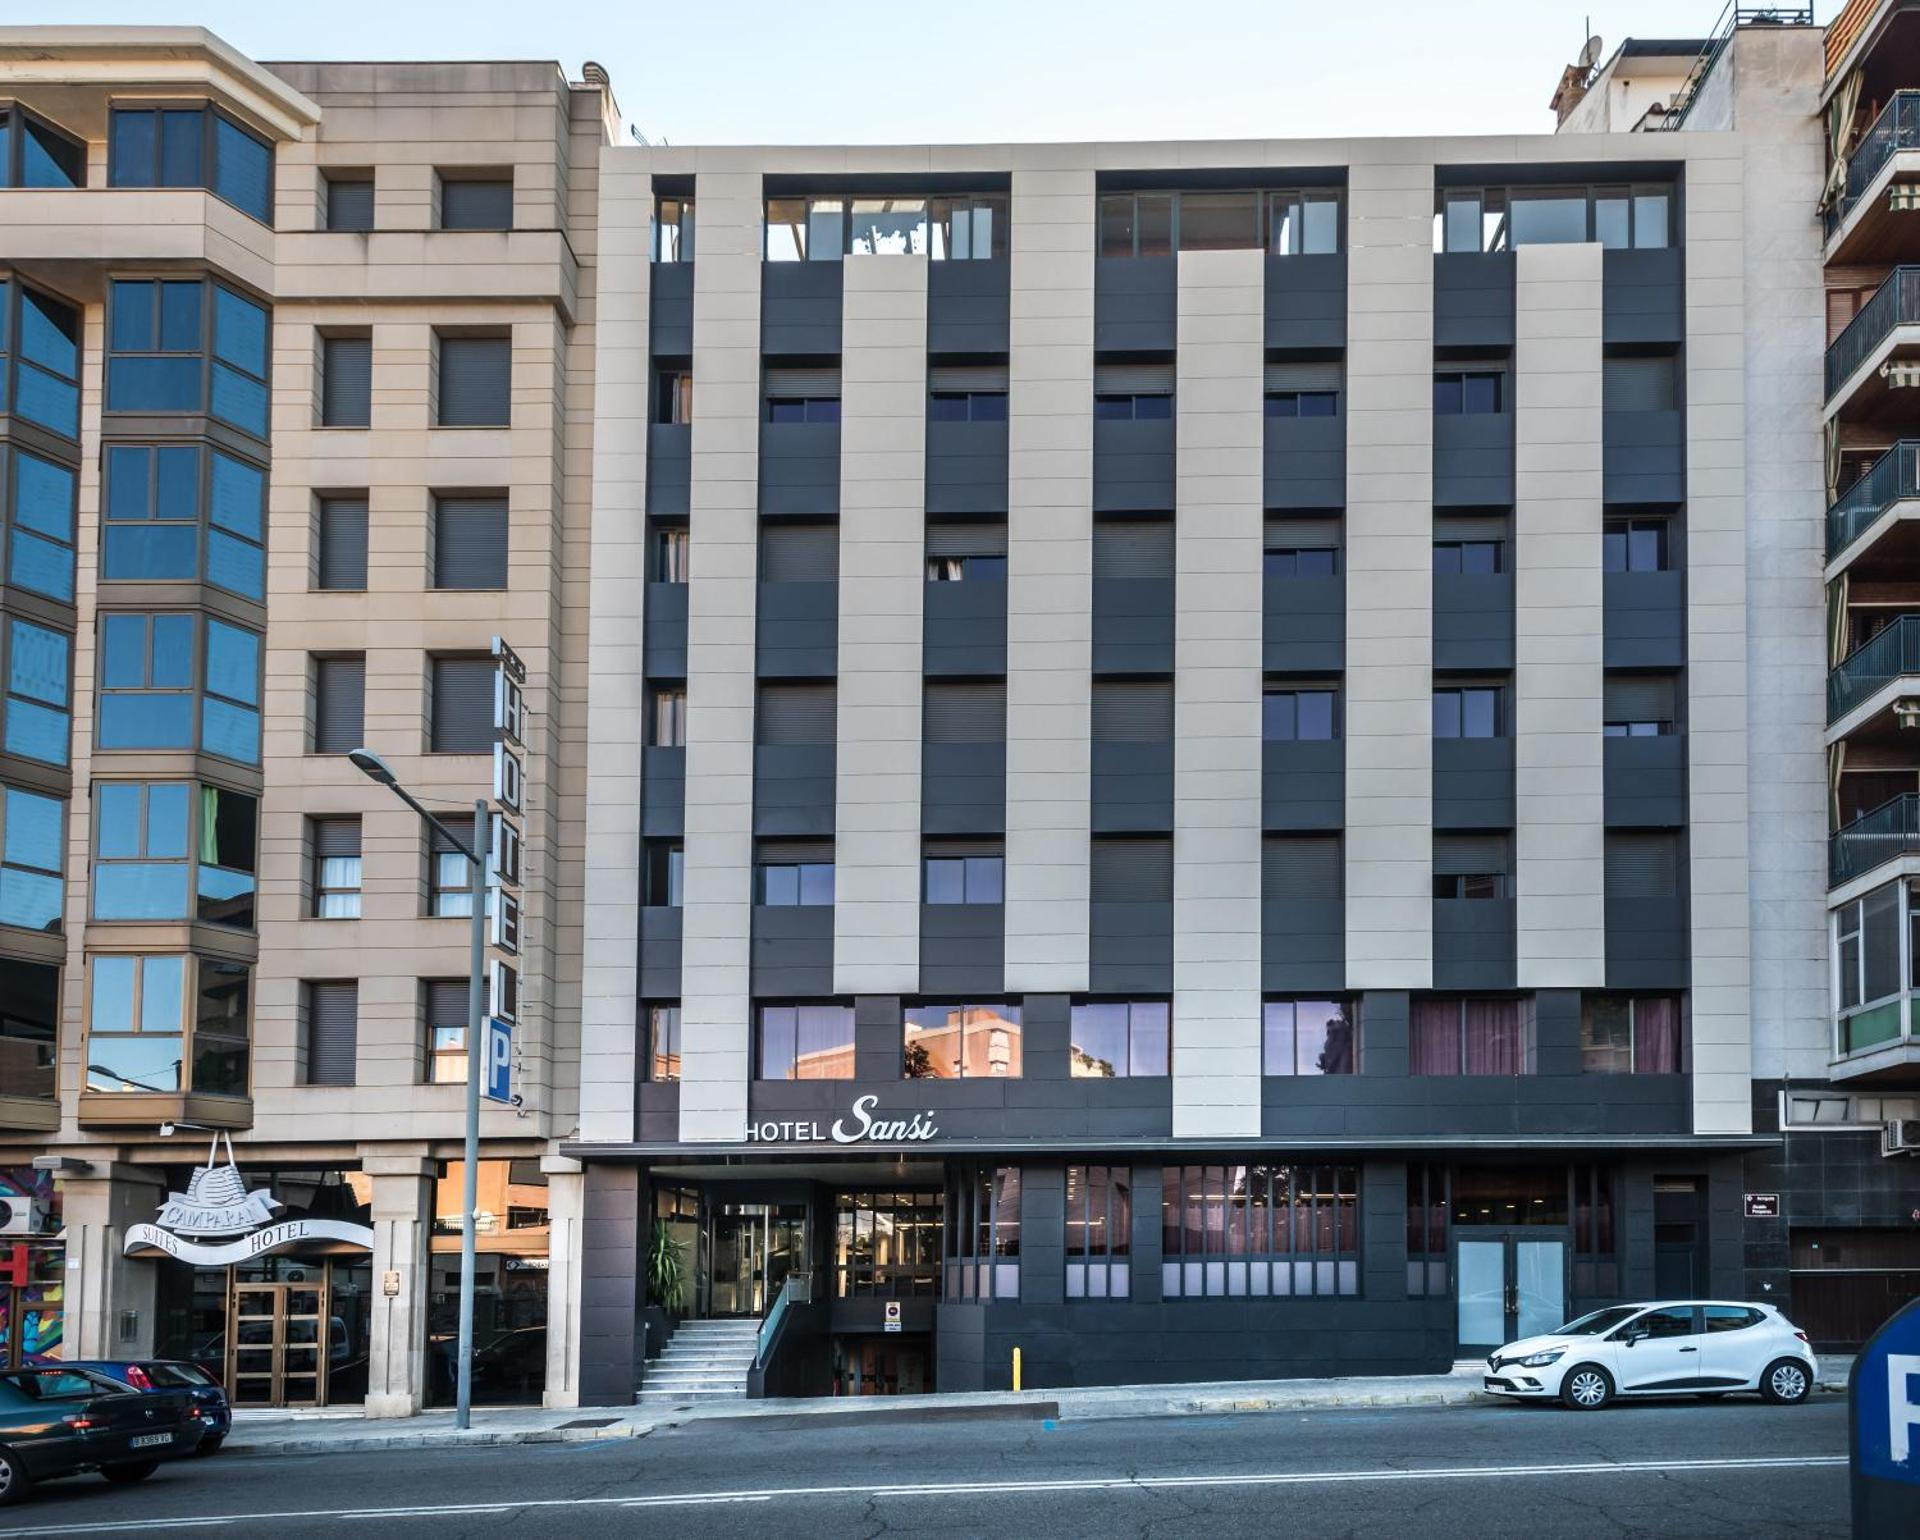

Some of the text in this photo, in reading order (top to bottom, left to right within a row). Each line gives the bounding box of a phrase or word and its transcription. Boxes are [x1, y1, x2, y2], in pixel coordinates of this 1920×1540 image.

[500, 674, 521, 1023] HOTEL
[489, 1029, 510, 1089] P
[744, 1094, 939, 1144] HOTEL Sansi
[142, 1222, 310, 1255] SUITES HOTEL
